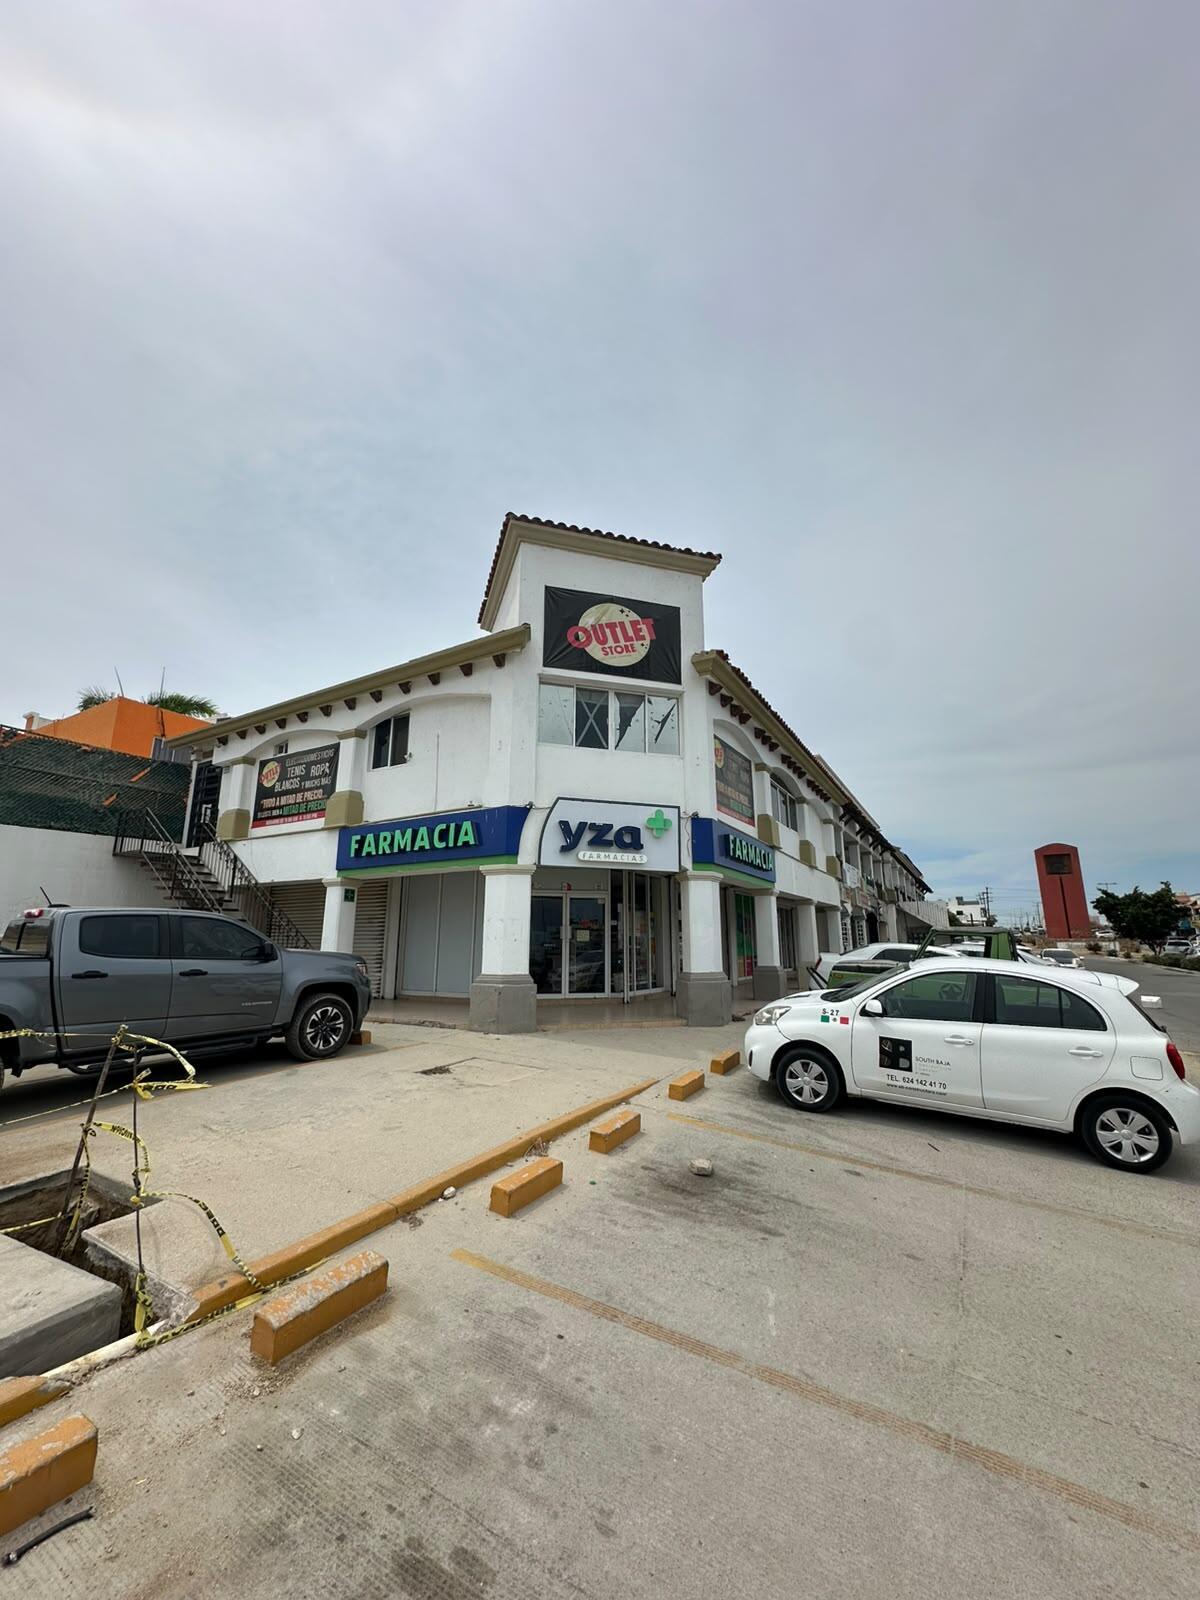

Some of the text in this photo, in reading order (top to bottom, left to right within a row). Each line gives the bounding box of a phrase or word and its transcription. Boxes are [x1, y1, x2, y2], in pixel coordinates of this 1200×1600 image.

[566, 617, 656, 649] OUTLET
[601, 644, 637, 656] STORE
[287, 763, 330, 778] TENIS ROPA
[274, 778, 300, 792] BLANCOS
[350, 820, 476, 857] FARMACIA
[558, 820, 644, 853] yza
[582, 852, 644, 861] FARMACIAS
[728, 834, 774, 871] FARMACIA
[902, 1076, 914, 1084] 624
[916, 1079, 927, 1087] 142
[929, 1080, 936, 1088] 41
[938, 1082, 947, 1090] 70
